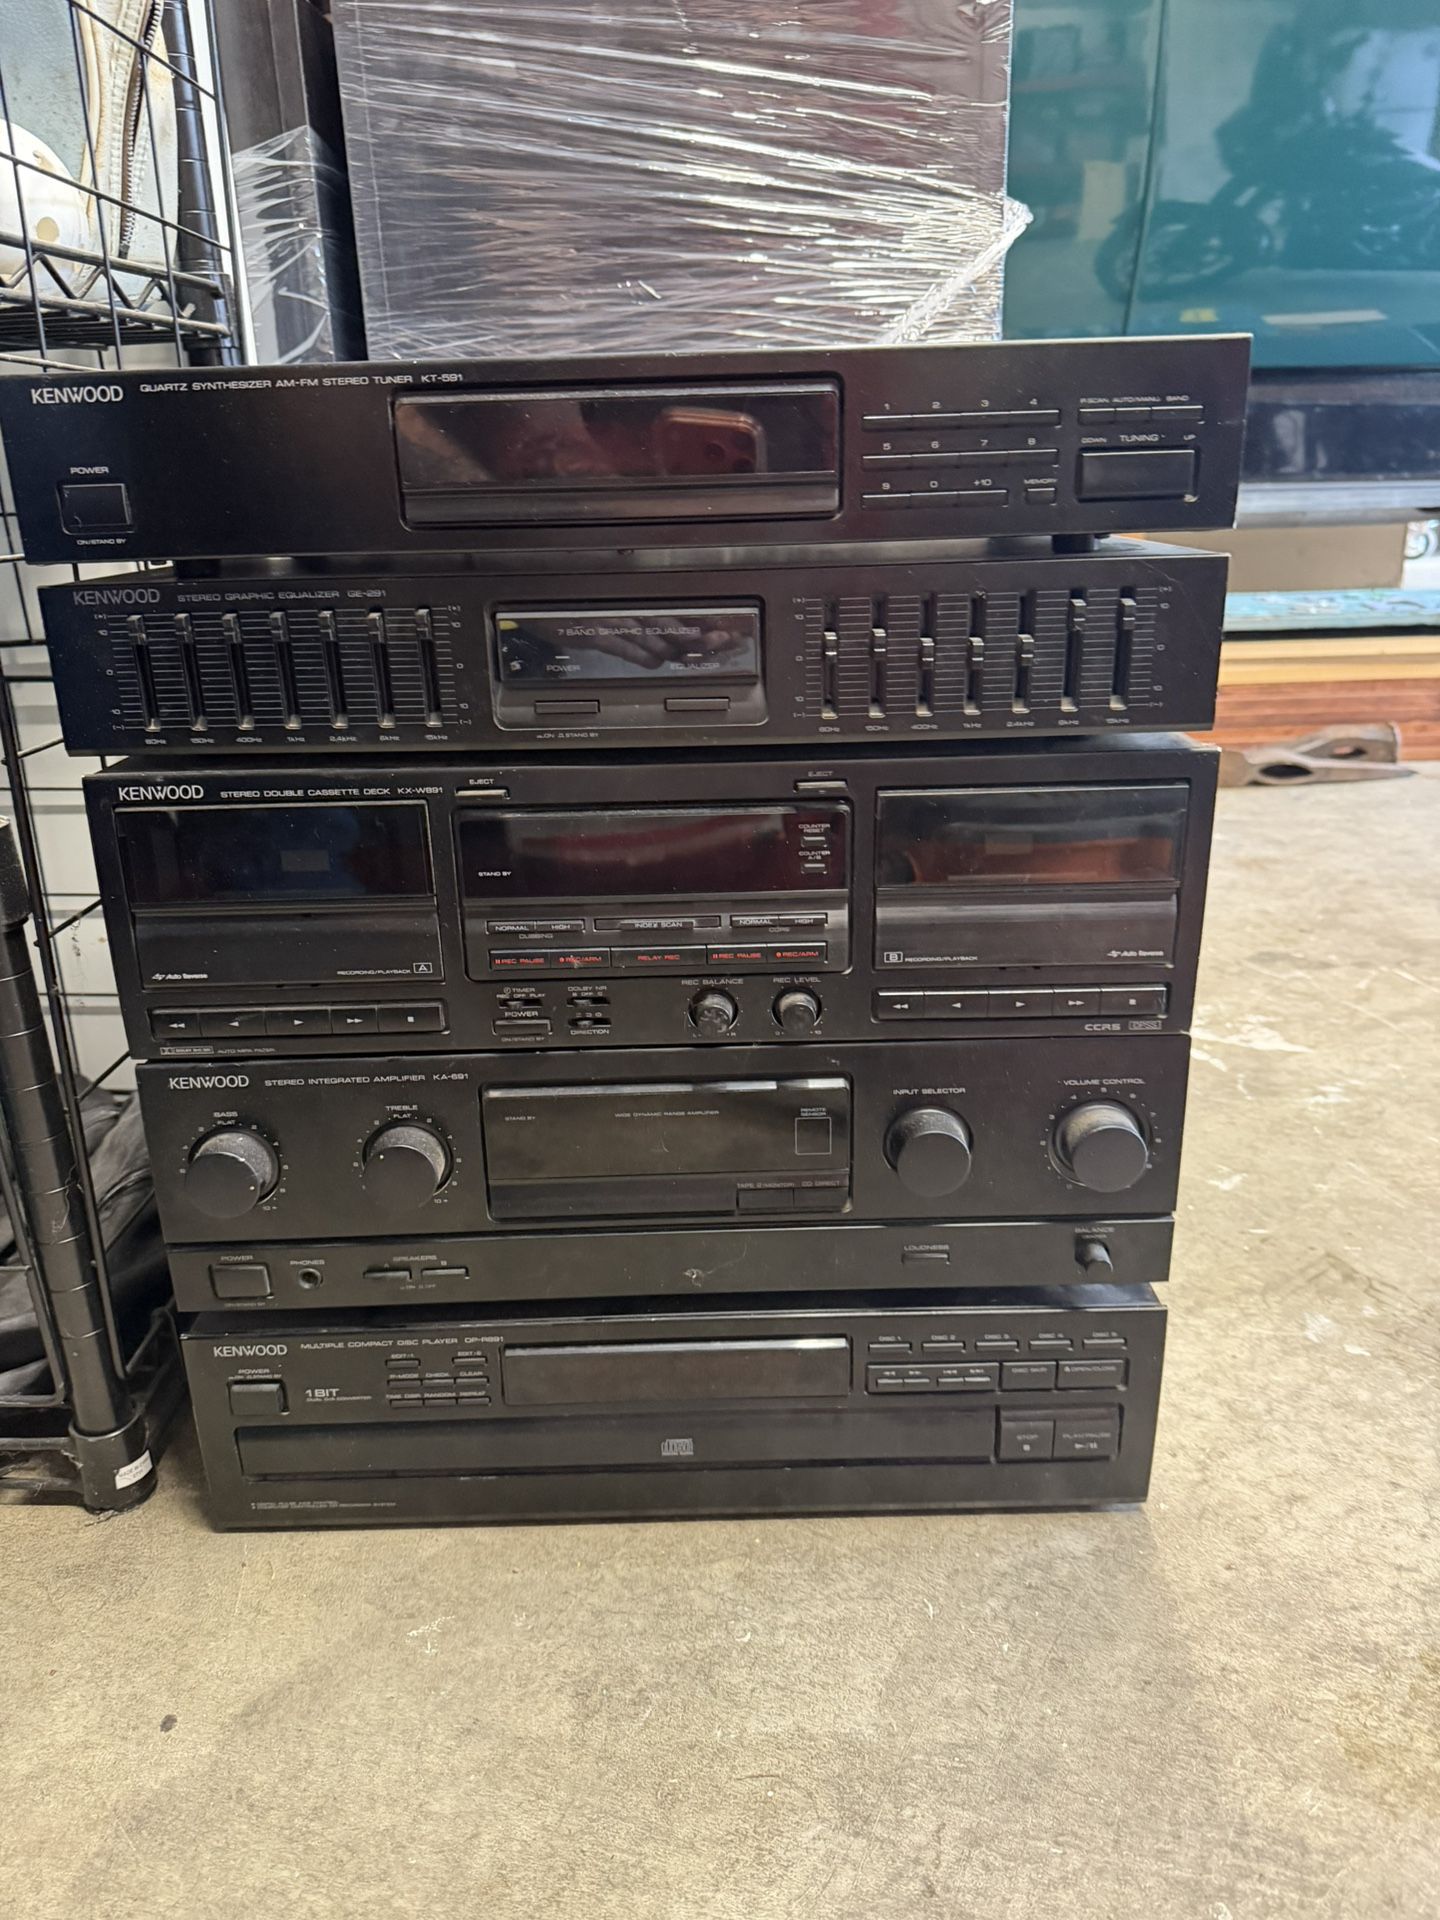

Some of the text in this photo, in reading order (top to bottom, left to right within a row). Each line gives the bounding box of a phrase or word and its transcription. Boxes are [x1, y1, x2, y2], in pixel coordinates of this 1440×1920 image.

[140, 373, 464, 393] QUARTZ SYNTHESIZER AM-FM STEREO TUNER KT-591
[31, 386, 124, 404] KENWOOD
[931, 402, 940, 410] 2
[981, 400, 989, 408] 3
[1029, 398, 1038, 406] 4
[884, 403, 890, 411] 1
[1119, 434, 1160, 442] TUNING
[883, 443, 891, 451] 5
[931, 441, 939, 449] 6
[980, 439, 988, 448] 7
[70, 466, 110, 474] POWER
[973, 479, 992, 487] +10
[73, 589, 160, 605] KENWOOD
[178, 593, 220, 602] STEREO
[224, 592, 274, 601] GRAPHIC
[278, 590, 340, 599] EQUALIZER
[566, 628, 596, 636] BAND
[599, 627, 642, 636] GRAPHIC
[645, 627, 700, 635] EQUALIZER
[546, 665, 581, 673] POWER
[670, 663, 721, 671] EQUALIZER
[118, 786, 204, 800] KENWOOD
[263, 789, 304, 797] DOUBLE
[307, 788, 360, 796] CASSETTE
[363, 787, 391, 795] DECK
[661, 920, 683, 929] SCAN
[739, 917, 773, 926] NORMAL
[795, 917, 814, 925] HIGH
[495, 924, 530, 932] NORMAL
[551, 923, 571, 931] HIGH
[637, 953, 681, 962] RELAY REC
[718, 951, 762, 960] REC PAUSE
[889, 953, 898, 961] B
[501, 957, 545, 965] REC PAUSE
[418, 964, 428, 972] A
[702, 977, 744, 986] BALANCE
[504, 1010, 539, 1018] POWER
[169, 1075, 249, 1089] KENWOOD
[265, 1079, 304, 1087] STEREO
[308, 1076, 370, 1085] INTEGRATED
[373, 1074, 426, 1083] AMPLIFIER
[922, 1087, 966, 1095] SELECTOR
[347, 1340, 394, 1348] COMPACT
[214, 1344, 288, 1357] KENWOOD
[306, 1388, 339, 1397] 1 BIT
